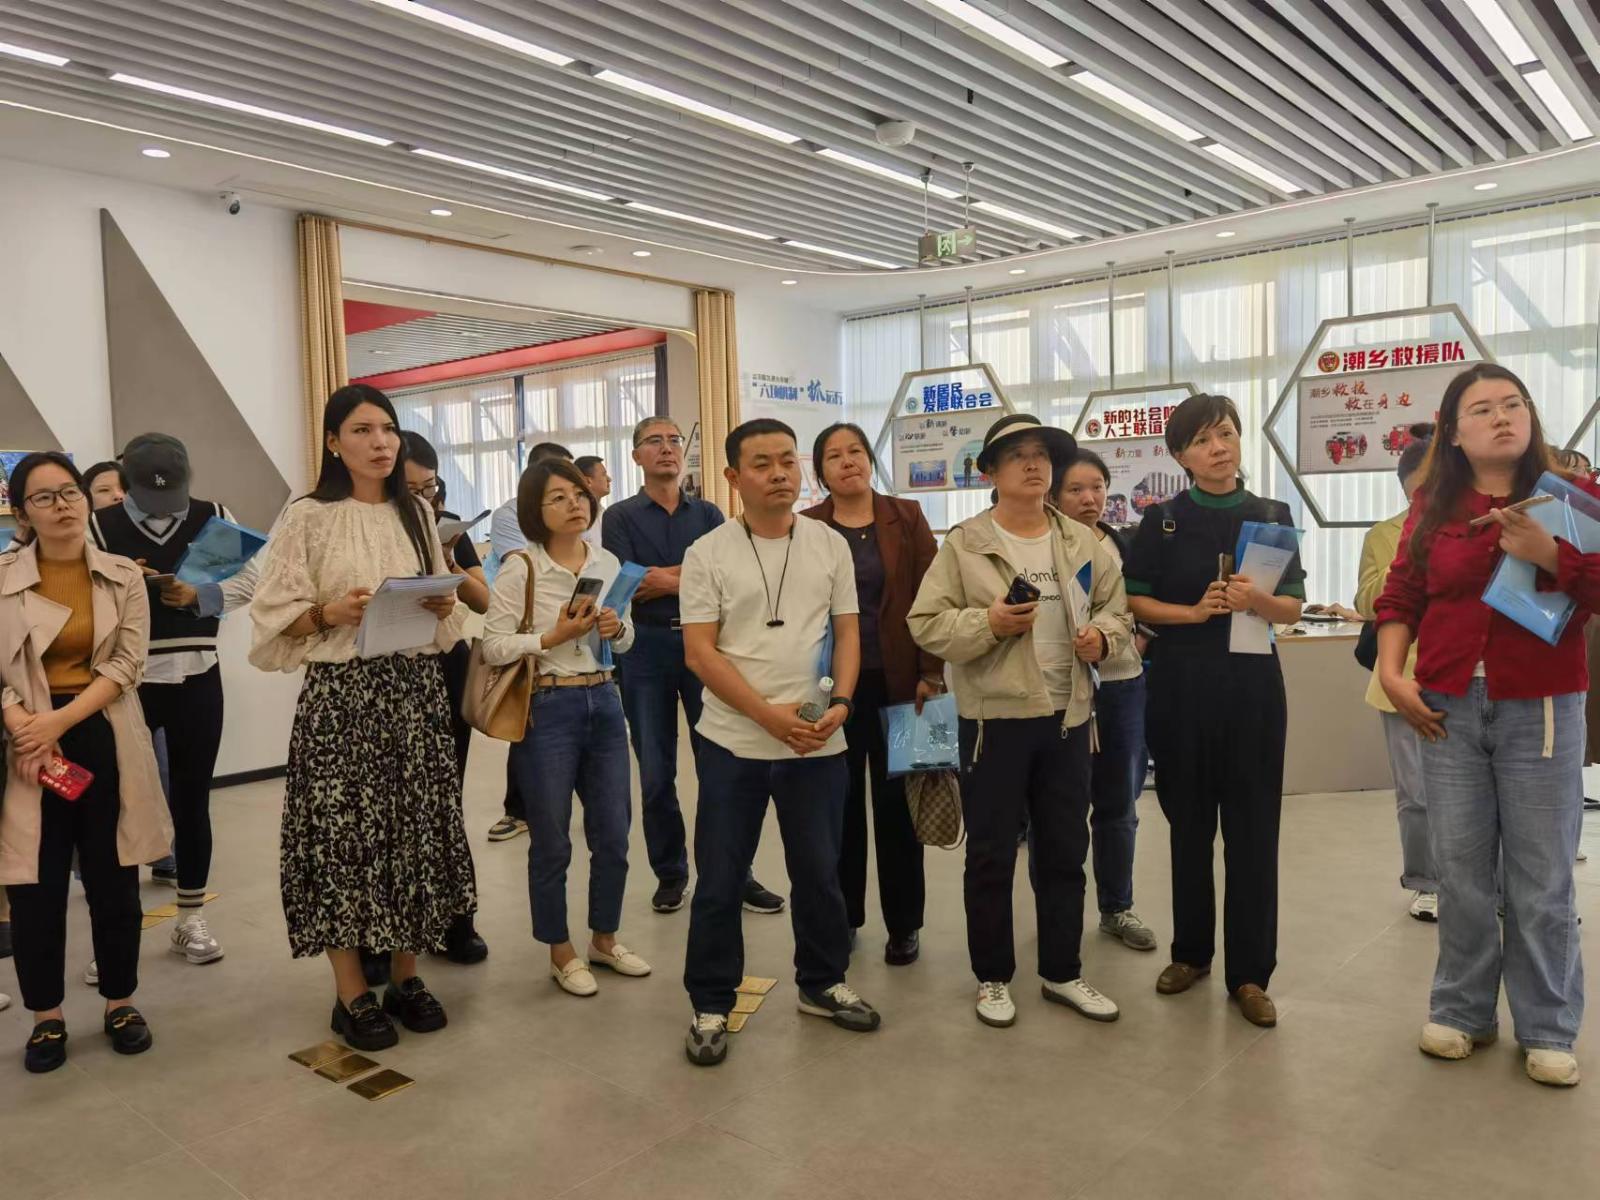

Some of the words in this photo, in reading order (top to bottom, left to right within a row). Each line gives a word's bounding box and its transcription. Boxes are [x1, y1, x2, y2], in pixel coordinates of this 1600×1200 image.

[1343, 341, 1466, 372] 潮乡救援队
[923, 382, 963, 401] 新居民
[924, 392, 993, 413] 发展联合会
[1105, 420, 1168, 438] 人士联谊
